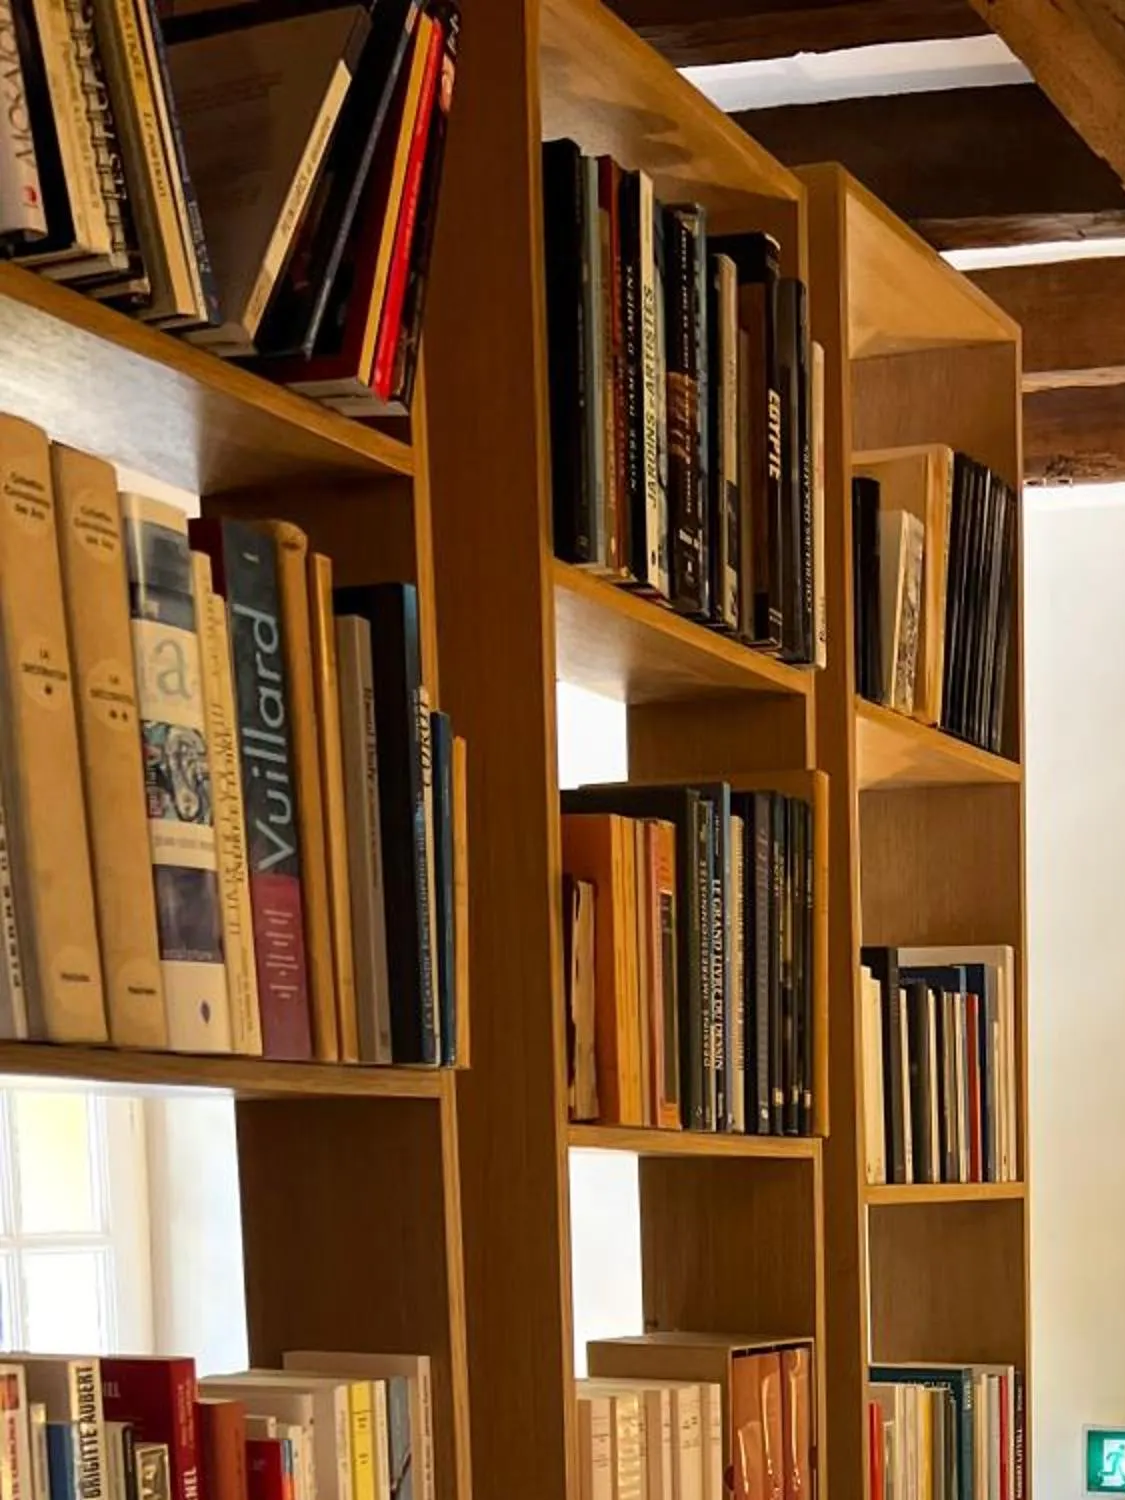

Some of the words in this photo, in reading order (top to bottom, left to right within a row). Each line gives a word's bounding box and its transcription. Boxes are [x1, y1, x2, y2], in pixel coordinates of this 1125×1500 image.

[232, 603, 296, 871] Vuillard
[75, 1365, 97, 1425] AUBERT
[80, 1429, 102, 1499] BRIGITTE
